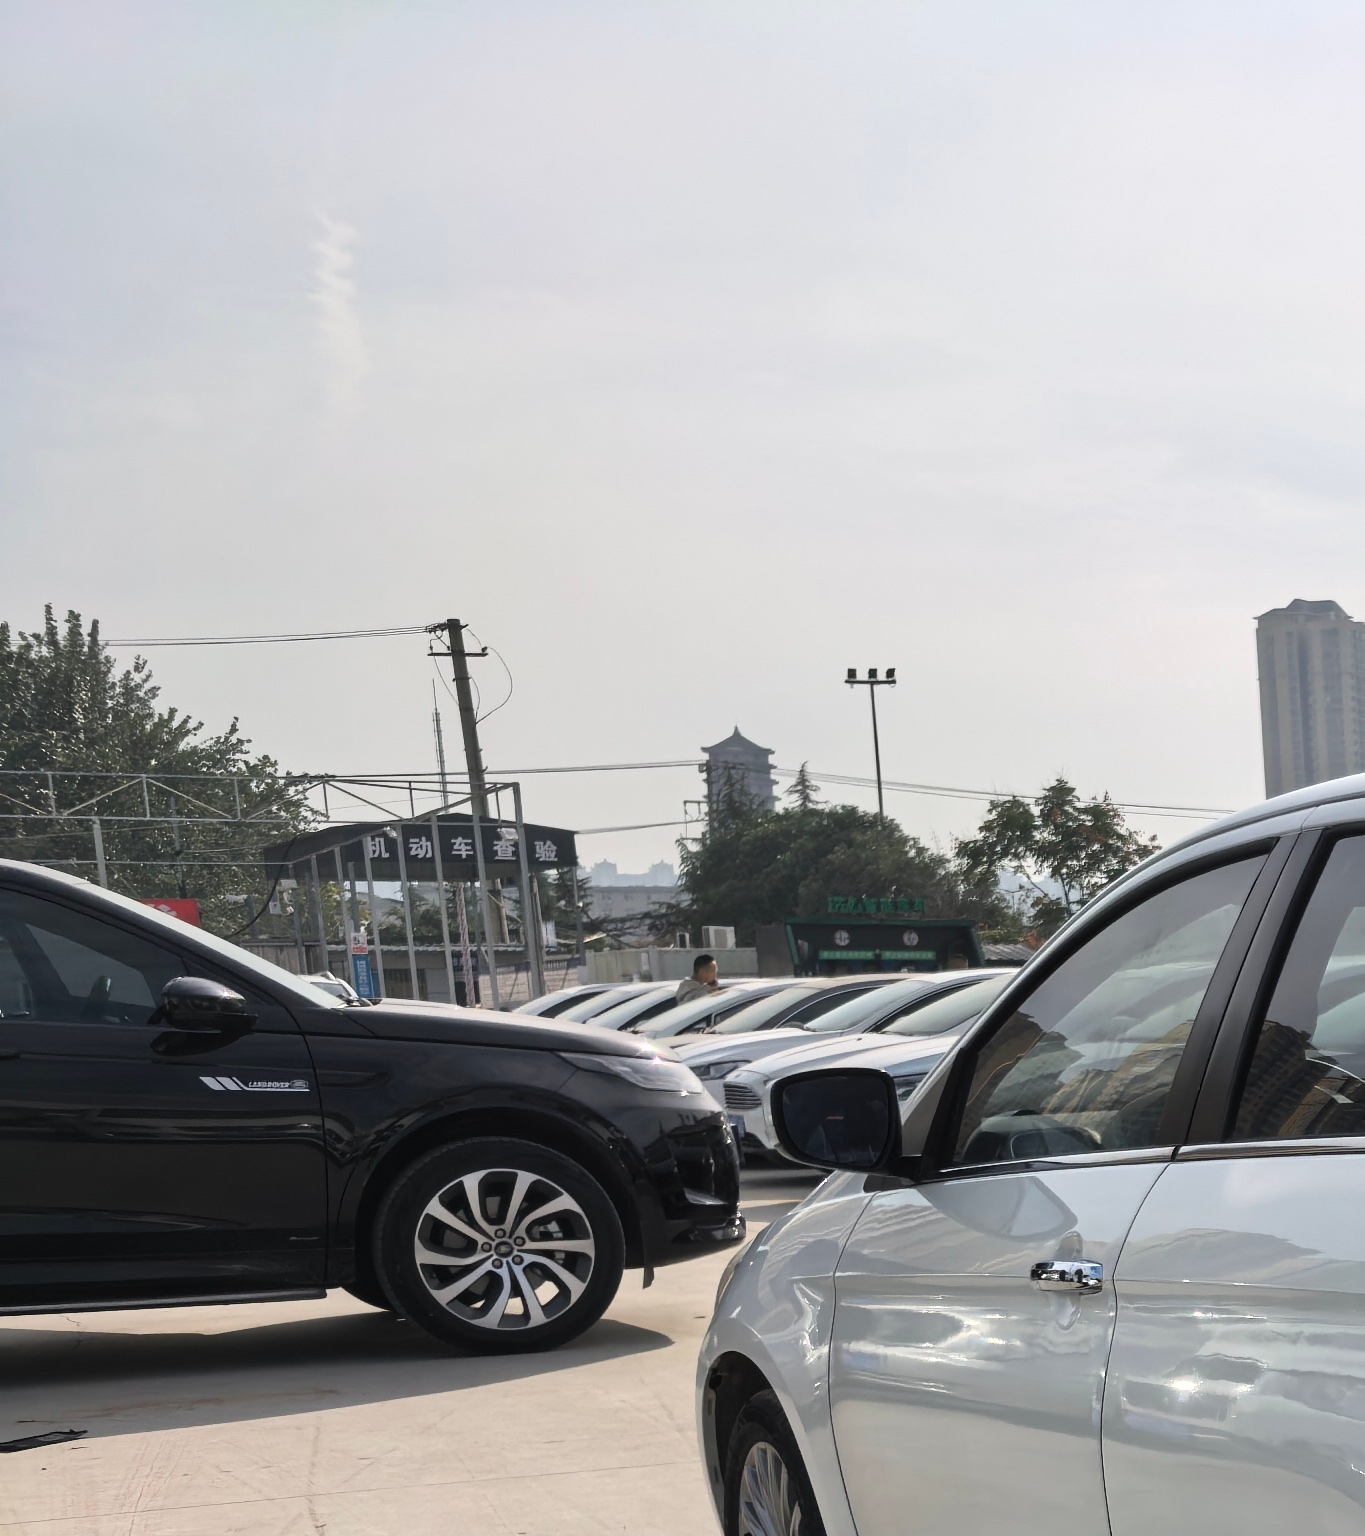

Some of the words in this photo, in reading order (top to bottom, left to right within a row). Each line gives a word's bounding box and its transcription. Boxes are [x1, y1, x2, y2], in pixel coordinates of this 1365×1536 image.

[368, 836, 558, 862] 机动车查验
